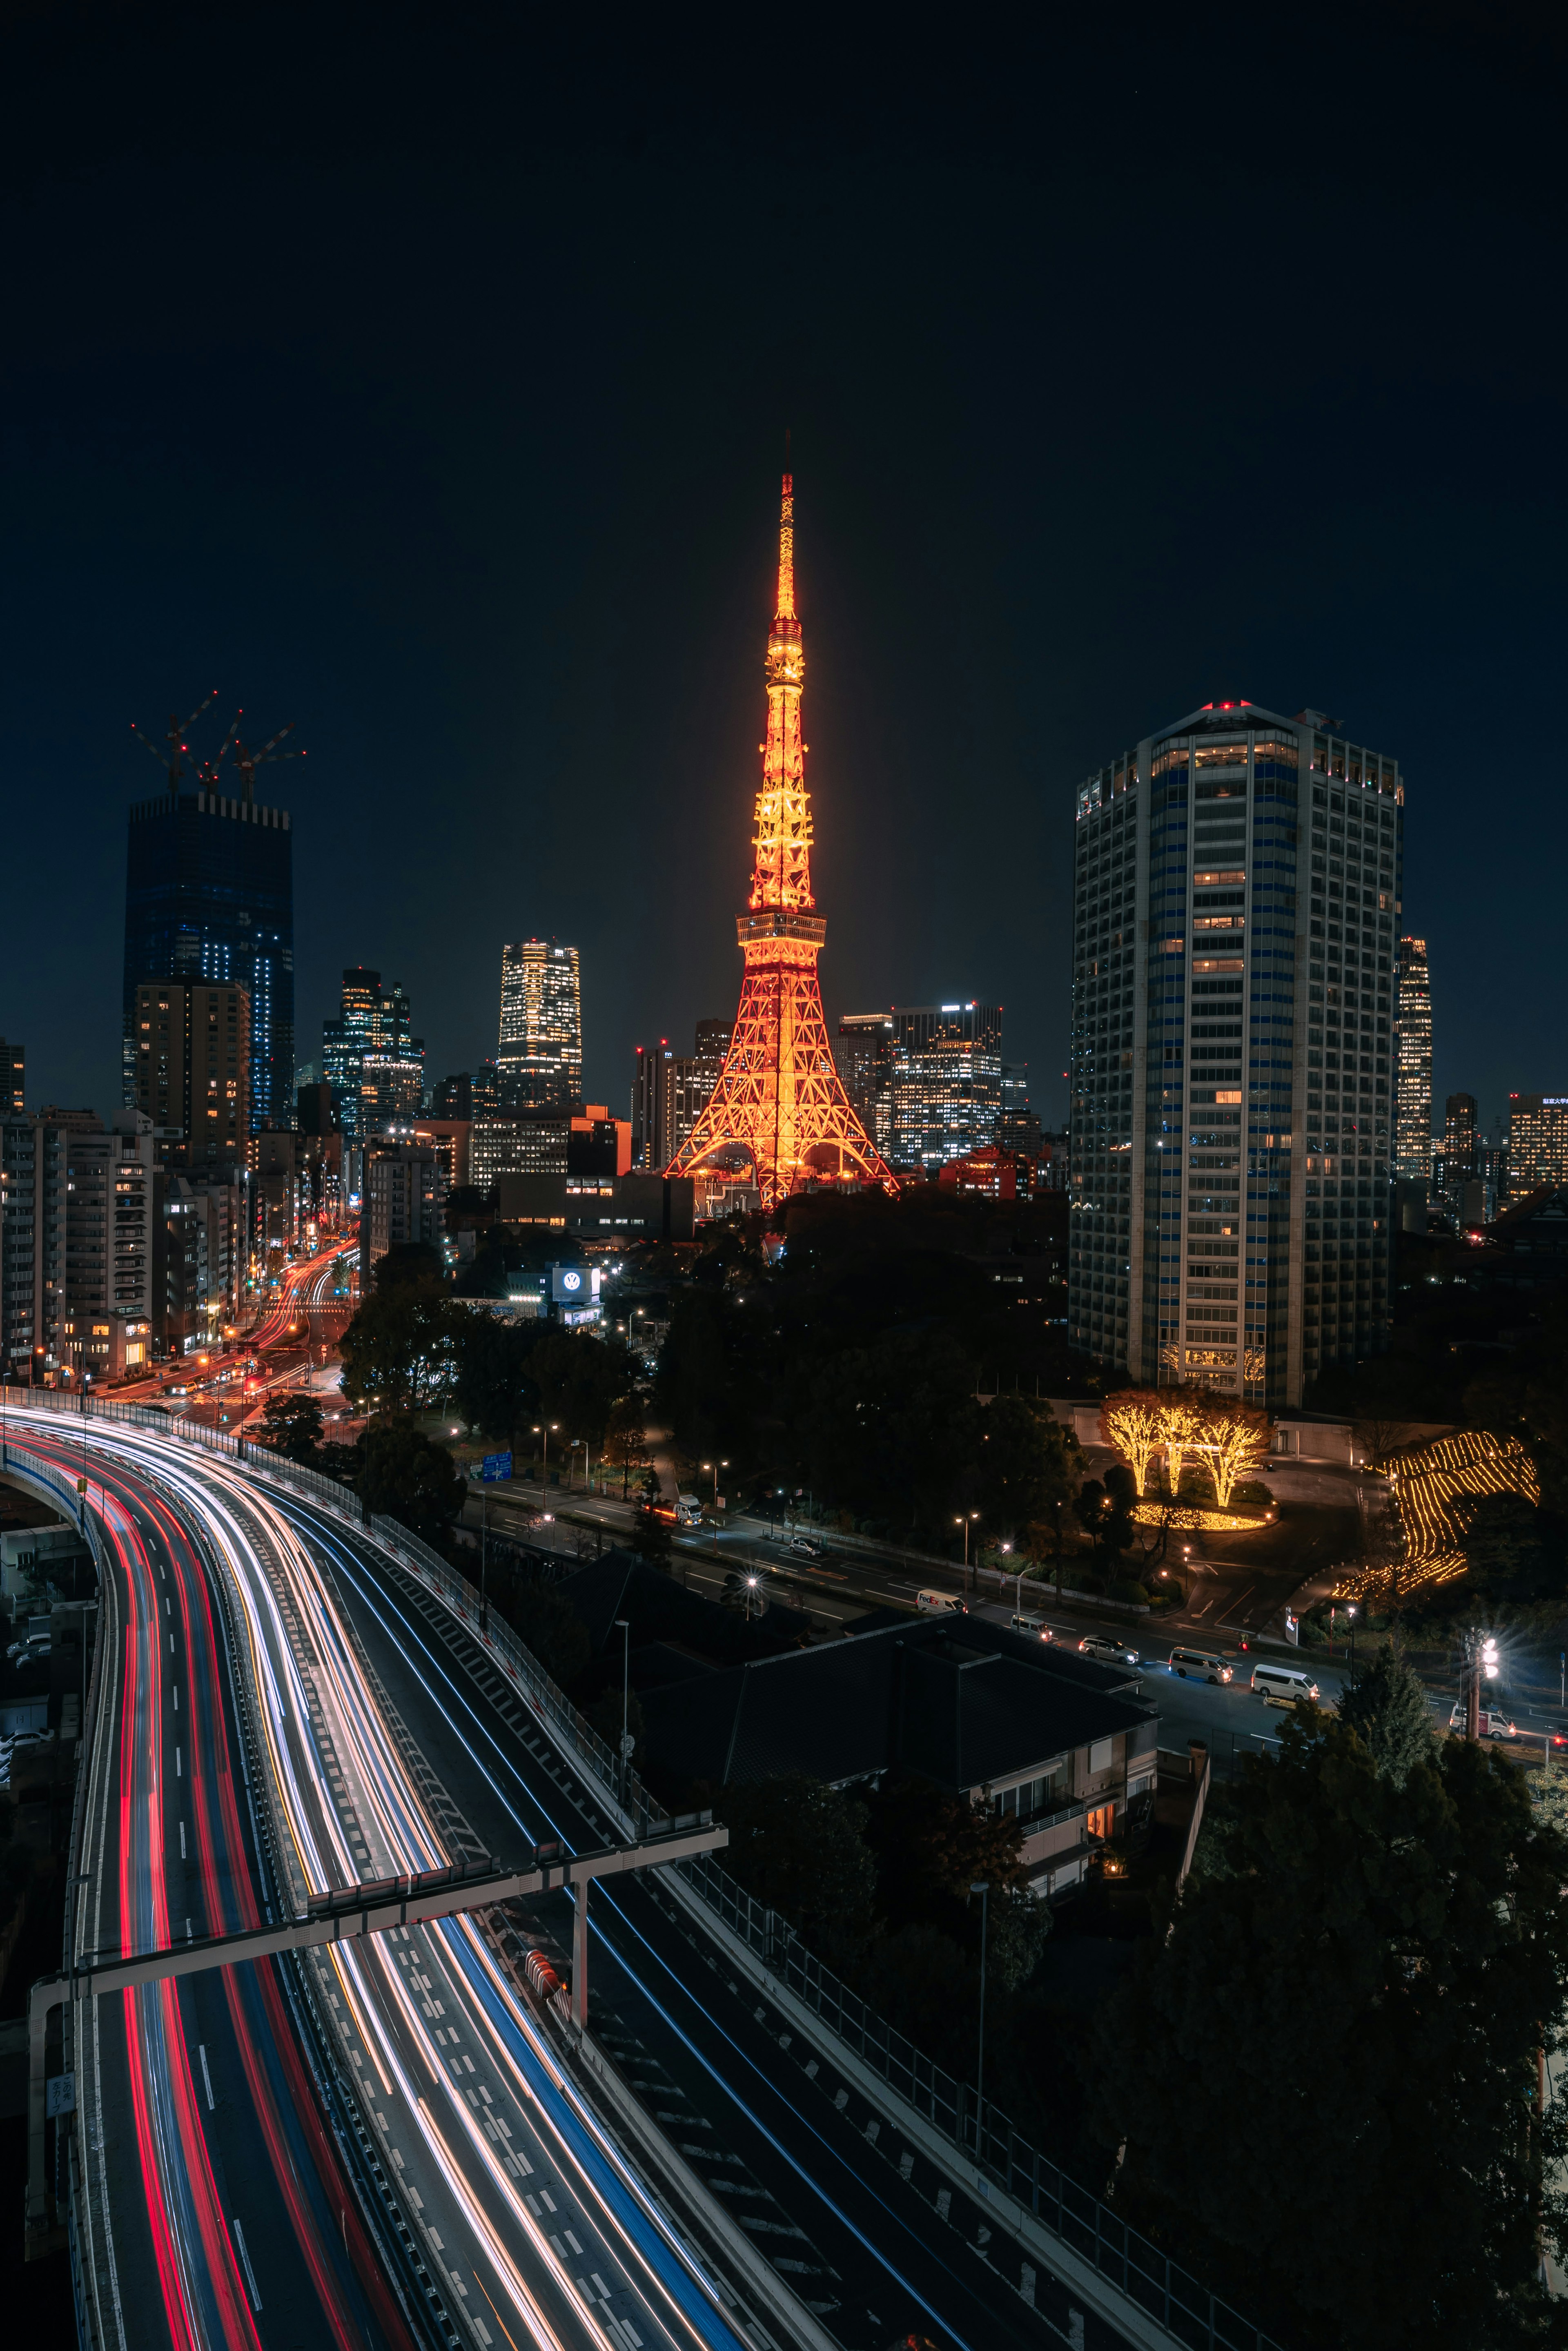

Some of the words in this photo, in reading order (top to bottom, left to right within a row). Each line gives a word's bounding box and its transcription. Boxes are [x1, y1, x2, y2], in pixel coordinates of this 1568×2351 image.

[920, 1593, 939, 1606] FedEx
[52, 2081, 61, 2114] 左カーブ
[63, 2076, 71, 2102] この先
